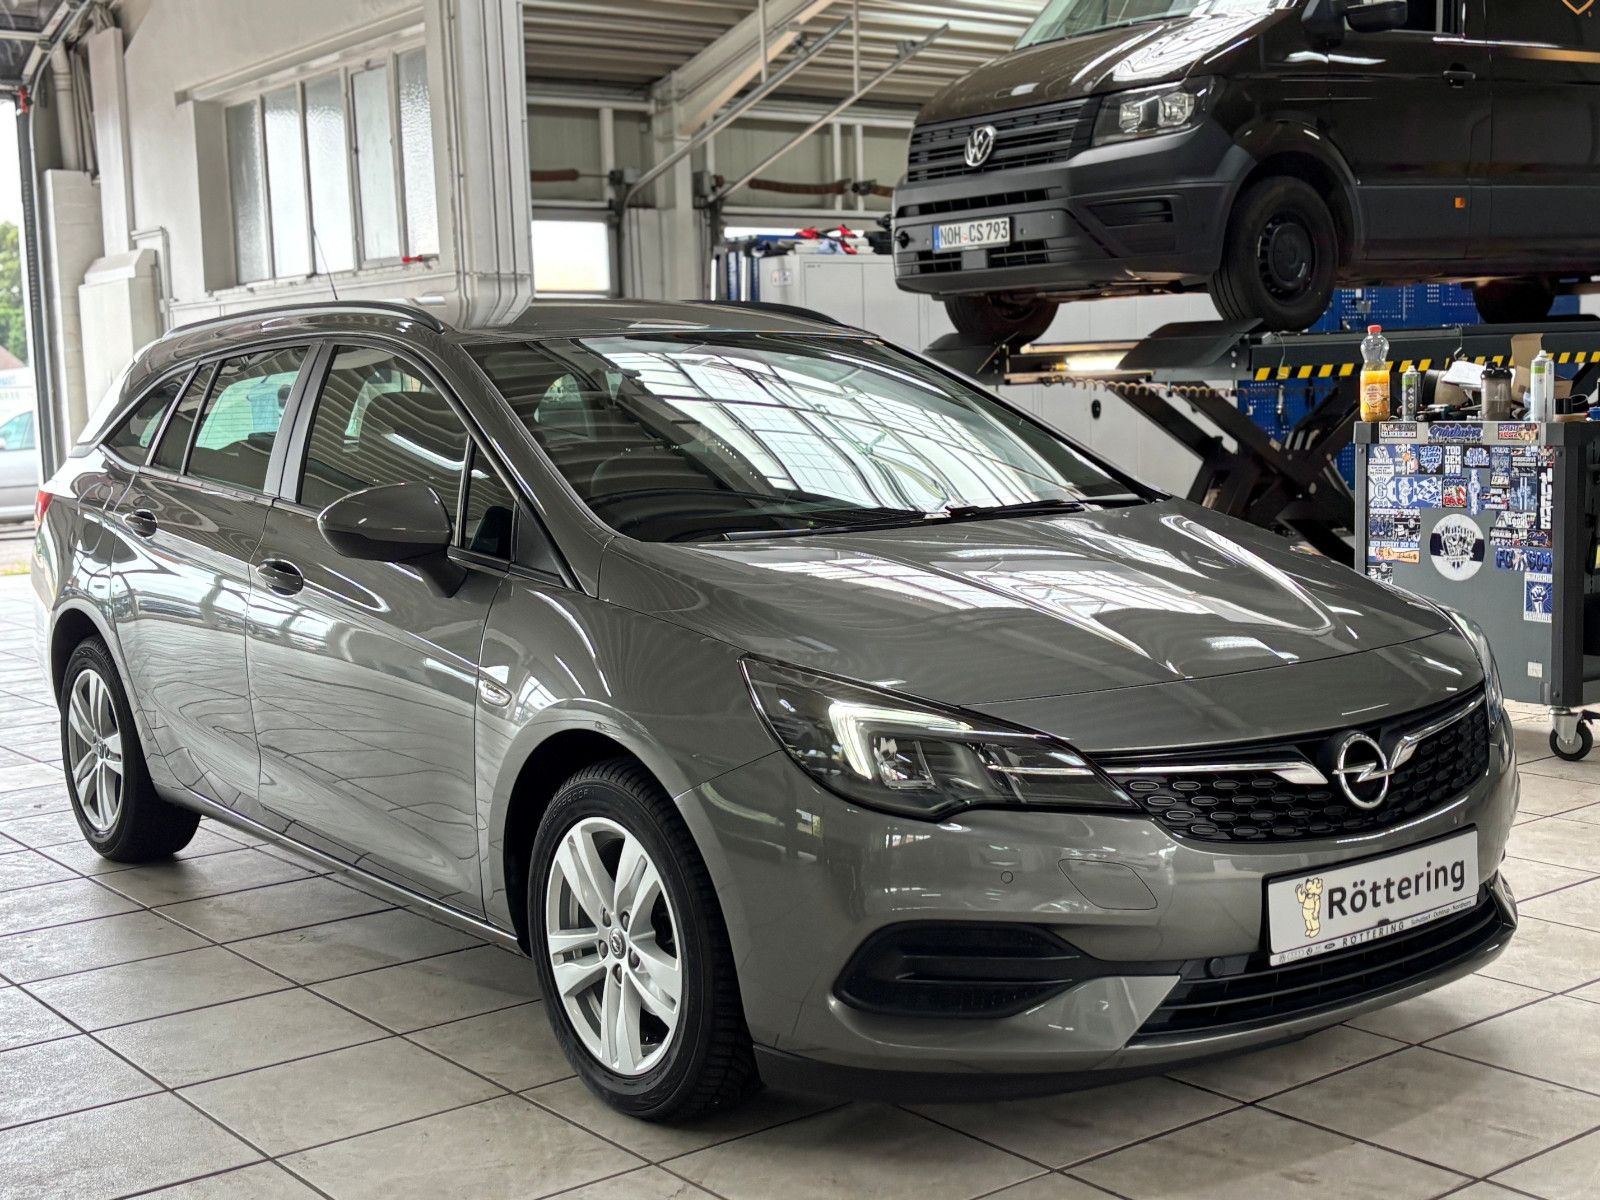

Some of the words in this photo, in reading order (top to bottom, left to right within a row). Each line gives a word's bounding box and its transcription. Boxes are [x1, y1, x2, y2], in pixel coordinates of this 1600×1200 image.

[941, 227, 961, 245] NOH
[1446, 446, 1461, 455] TOD
[1445, 455, 1462, 464] DEM
[1328, 859, 1465, 919] Röttering
